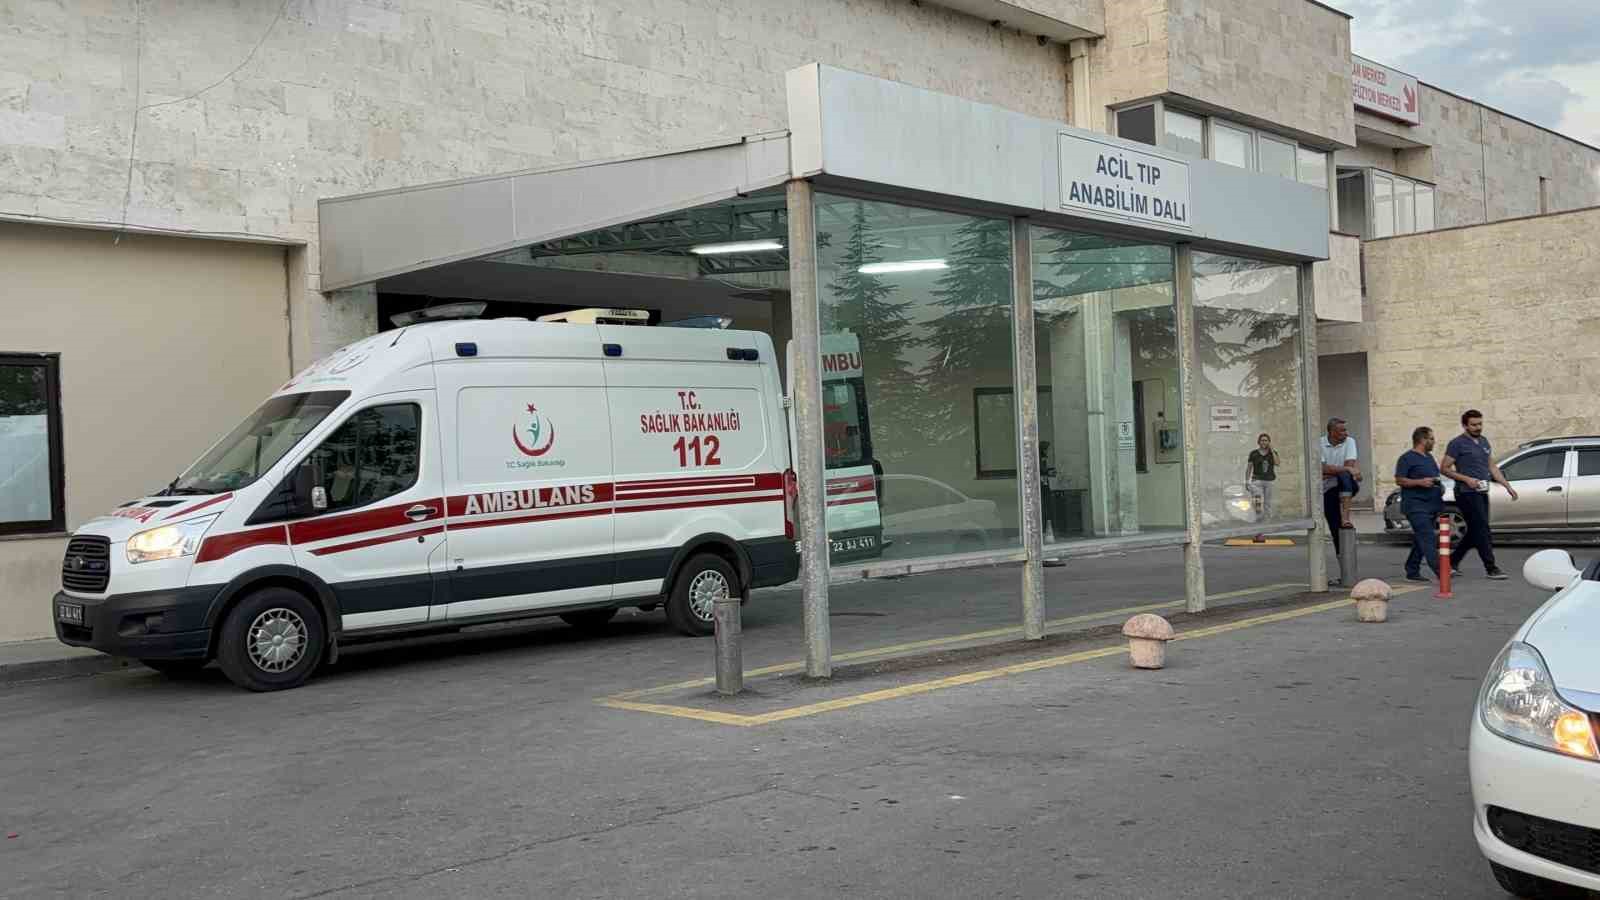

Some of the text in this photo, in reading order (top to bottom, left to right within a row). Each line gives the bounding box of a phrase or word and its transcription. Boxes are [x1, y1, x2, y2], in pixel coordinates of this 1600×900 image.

[1096, 153, 1161, 186] ACİL TIP
[1069, 181, 1186, 222] ANABİLİM DALI
[677, 391, 701, 410] T.C.
[640, 407, 741, 433] SAĞLIK BAKANLIĞI
[673, 435, 721, 467] 112
[464, 484, 595, 516] AMBULANS
